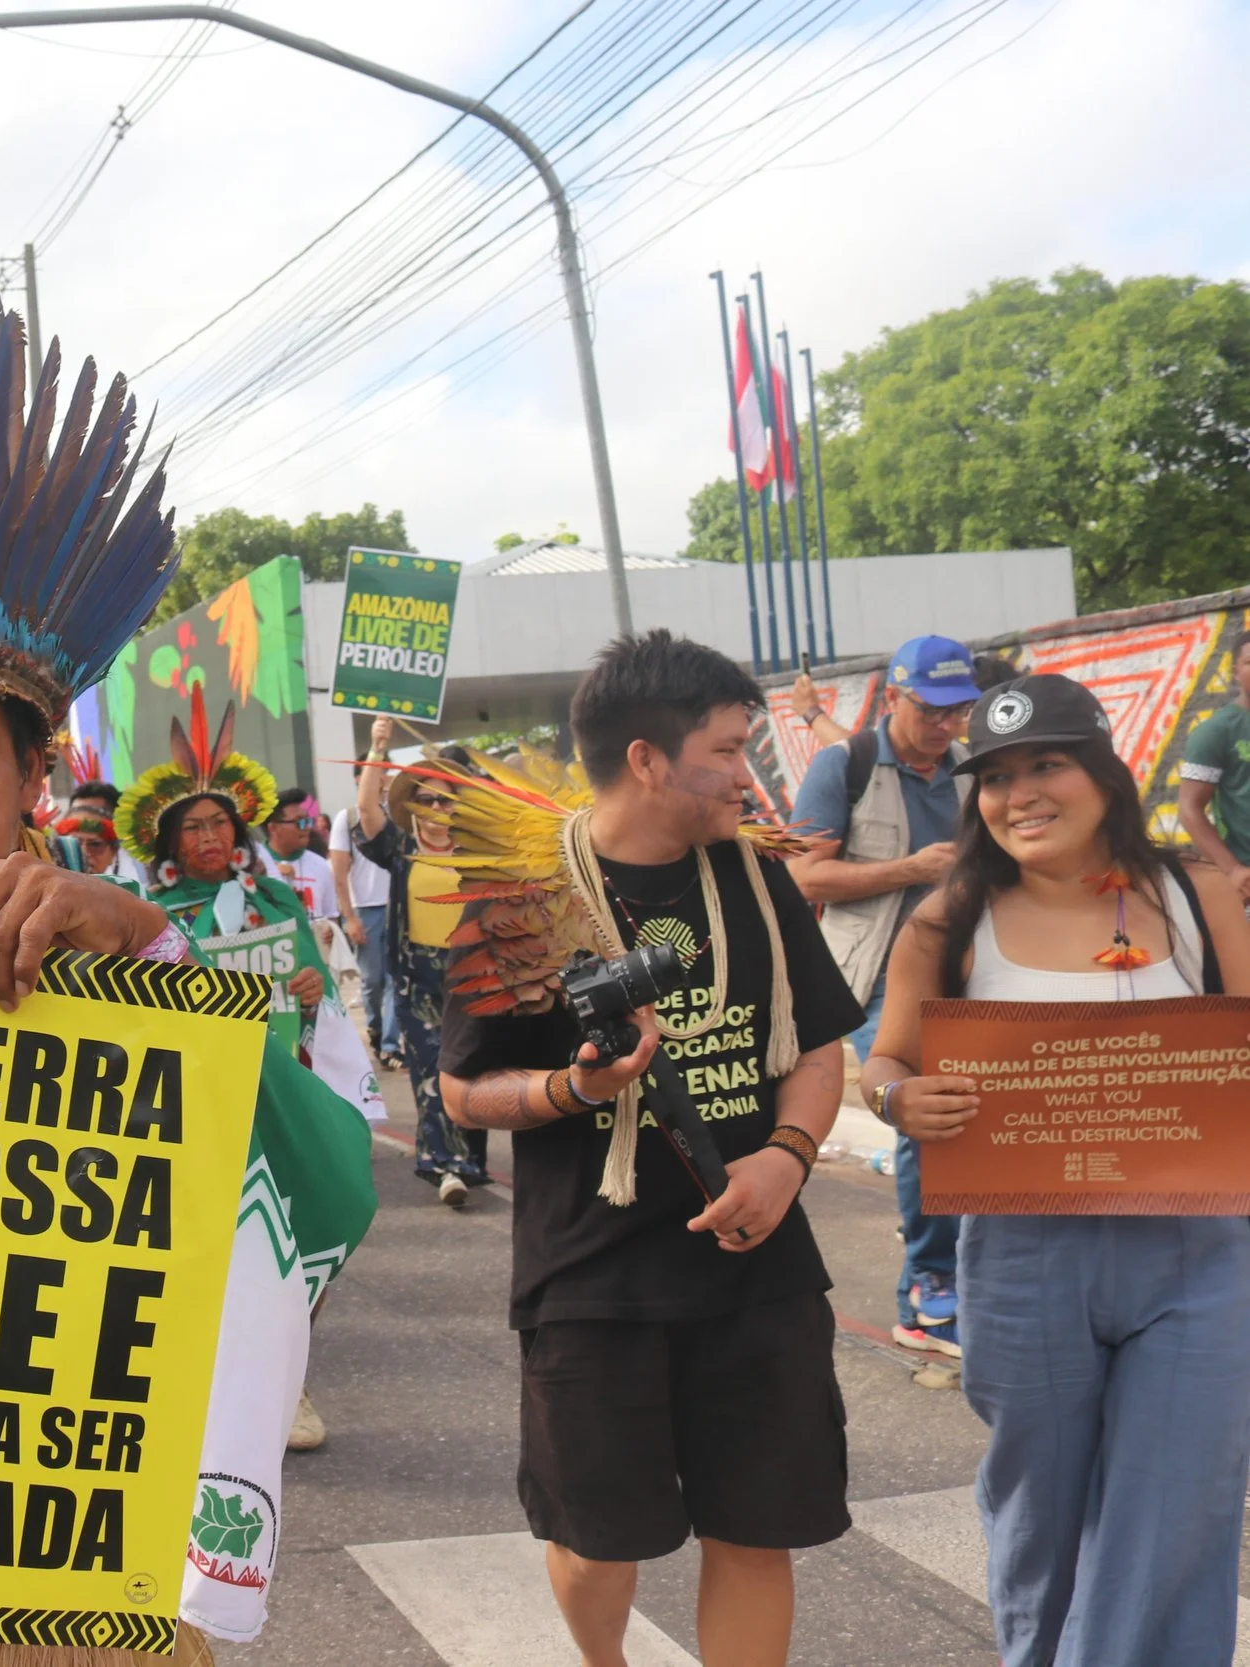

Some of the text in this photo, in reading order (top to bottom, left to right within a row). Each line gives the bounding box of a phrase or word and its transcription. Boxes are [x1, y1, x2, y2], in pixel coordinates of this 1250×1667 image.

[347, 592, 449, 625] AMAZÔNIA
[343, 615, 448, 654] LIVRE DE
[339, 642, 444, 678] PETRÓLEO
[1031, 1031, 1161, 1054] O QUE VOCÊS
[938, 1059, 1030, 1075] CHAMAM
[1033, 1057, 1059, 1072] DE
[981, 1073, 1099, 1092] CHAMAMOS
[1103, 1072, 1128, 1086] DE
[1044, 1089, 1142, 1107] WHAT YOU
[1003, 1106, 1183, 1126] CALL DEVELOPMENT,
[990, 1126, 1202, 1145] WE CALL DESTRUCTION.
[90, 1266, 166, 1404] E
[37, 1407, 147, 1474] SER
